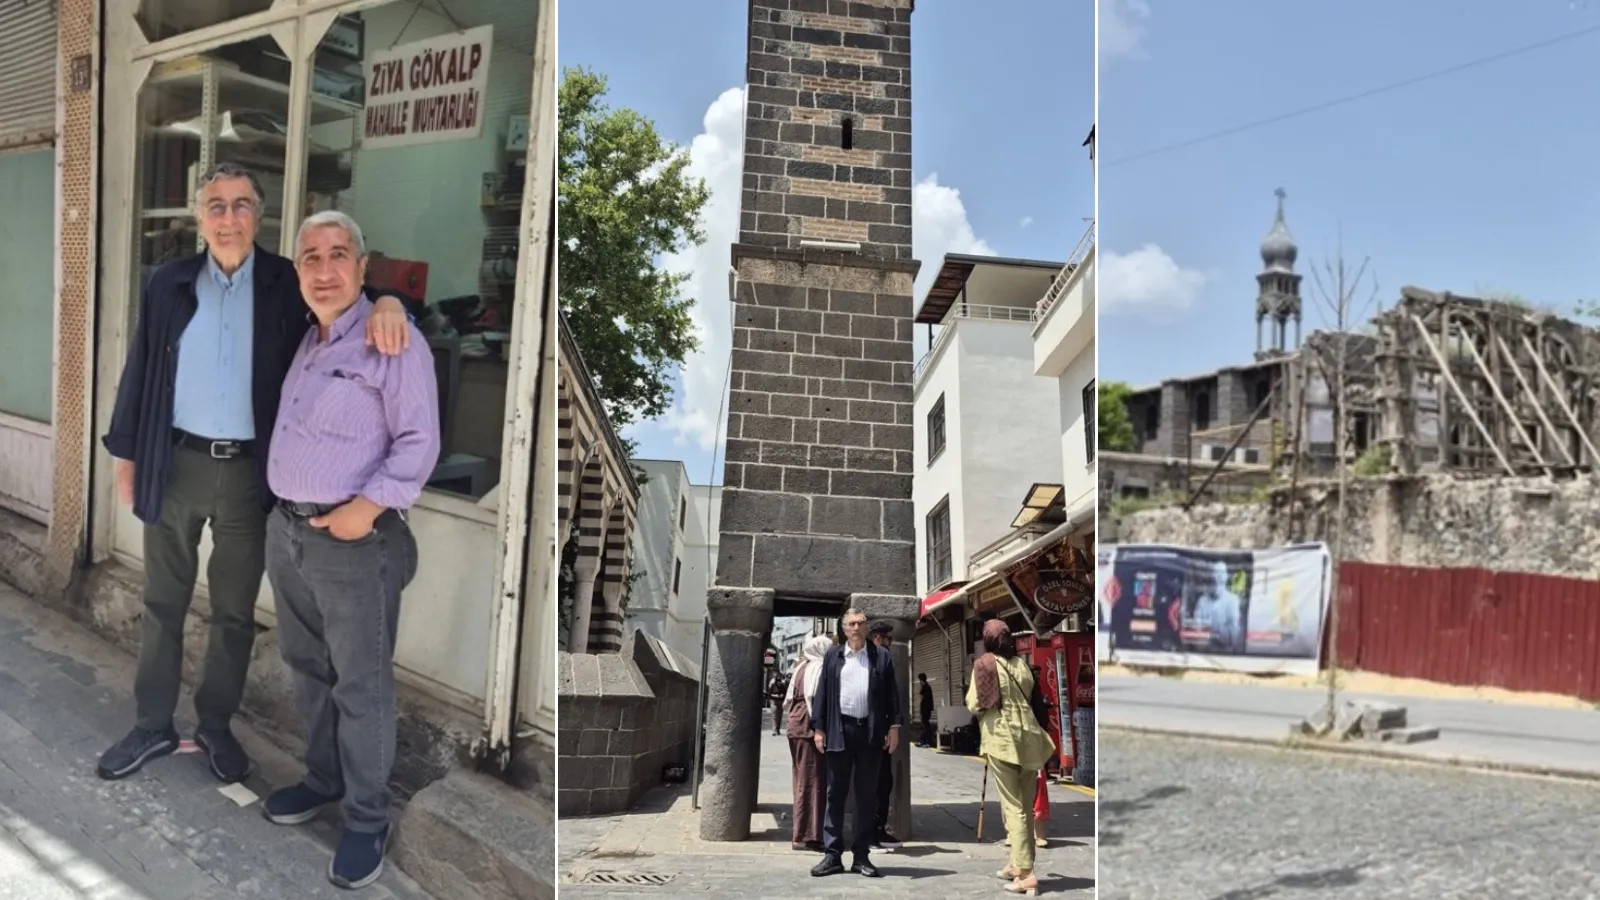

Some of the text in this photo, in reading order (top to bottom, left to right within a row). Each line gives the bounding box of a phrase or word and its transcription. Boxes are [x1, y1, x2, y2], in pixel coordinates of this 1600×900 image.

[409, 43, 482, 90] GÖKALP
[365, 87, 479, 138] MAHALLE MUHTARLIĞI
